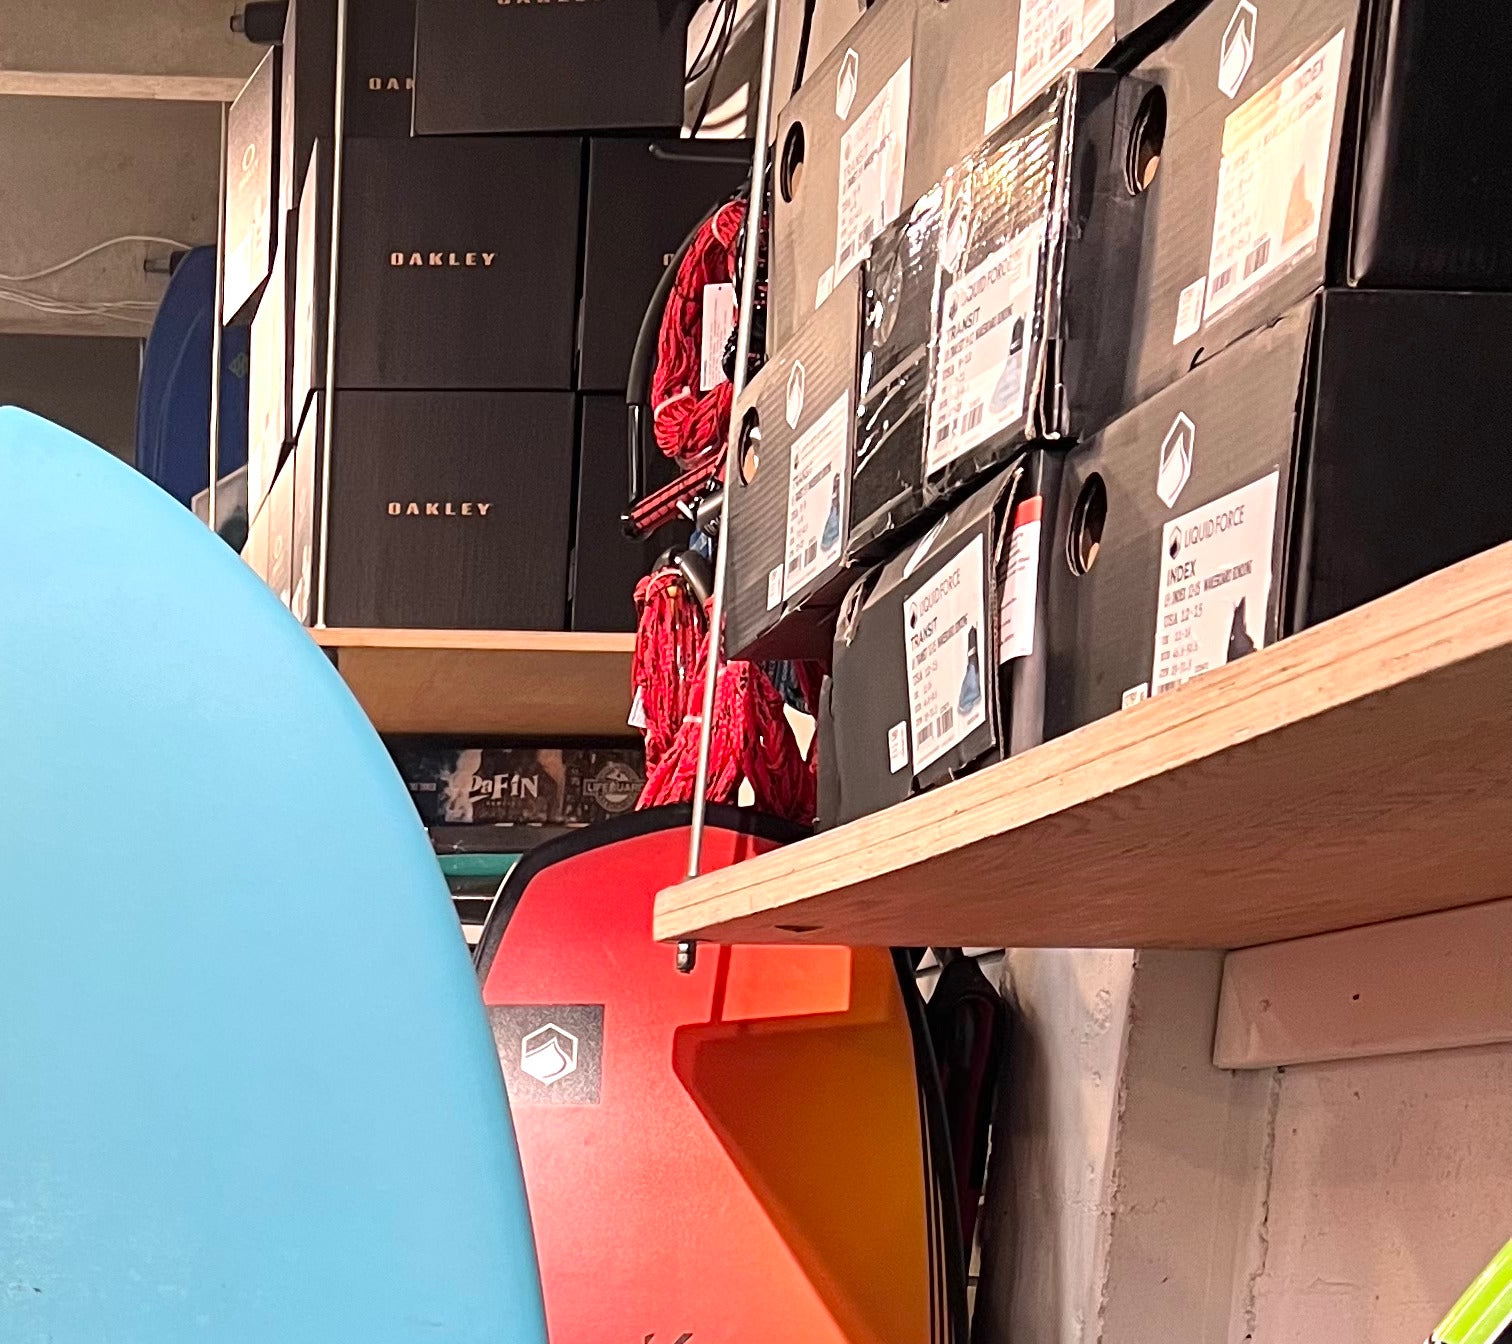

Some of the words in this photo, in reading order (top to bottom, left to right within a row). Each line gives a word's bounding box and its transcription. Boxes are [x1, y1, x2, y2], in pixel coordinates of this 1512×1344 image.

[390, 252, 496, 267] OAKLEY
[387, 502, 491, 516] OAKLEY
[1166, 558, 1196, 587] INDEX
